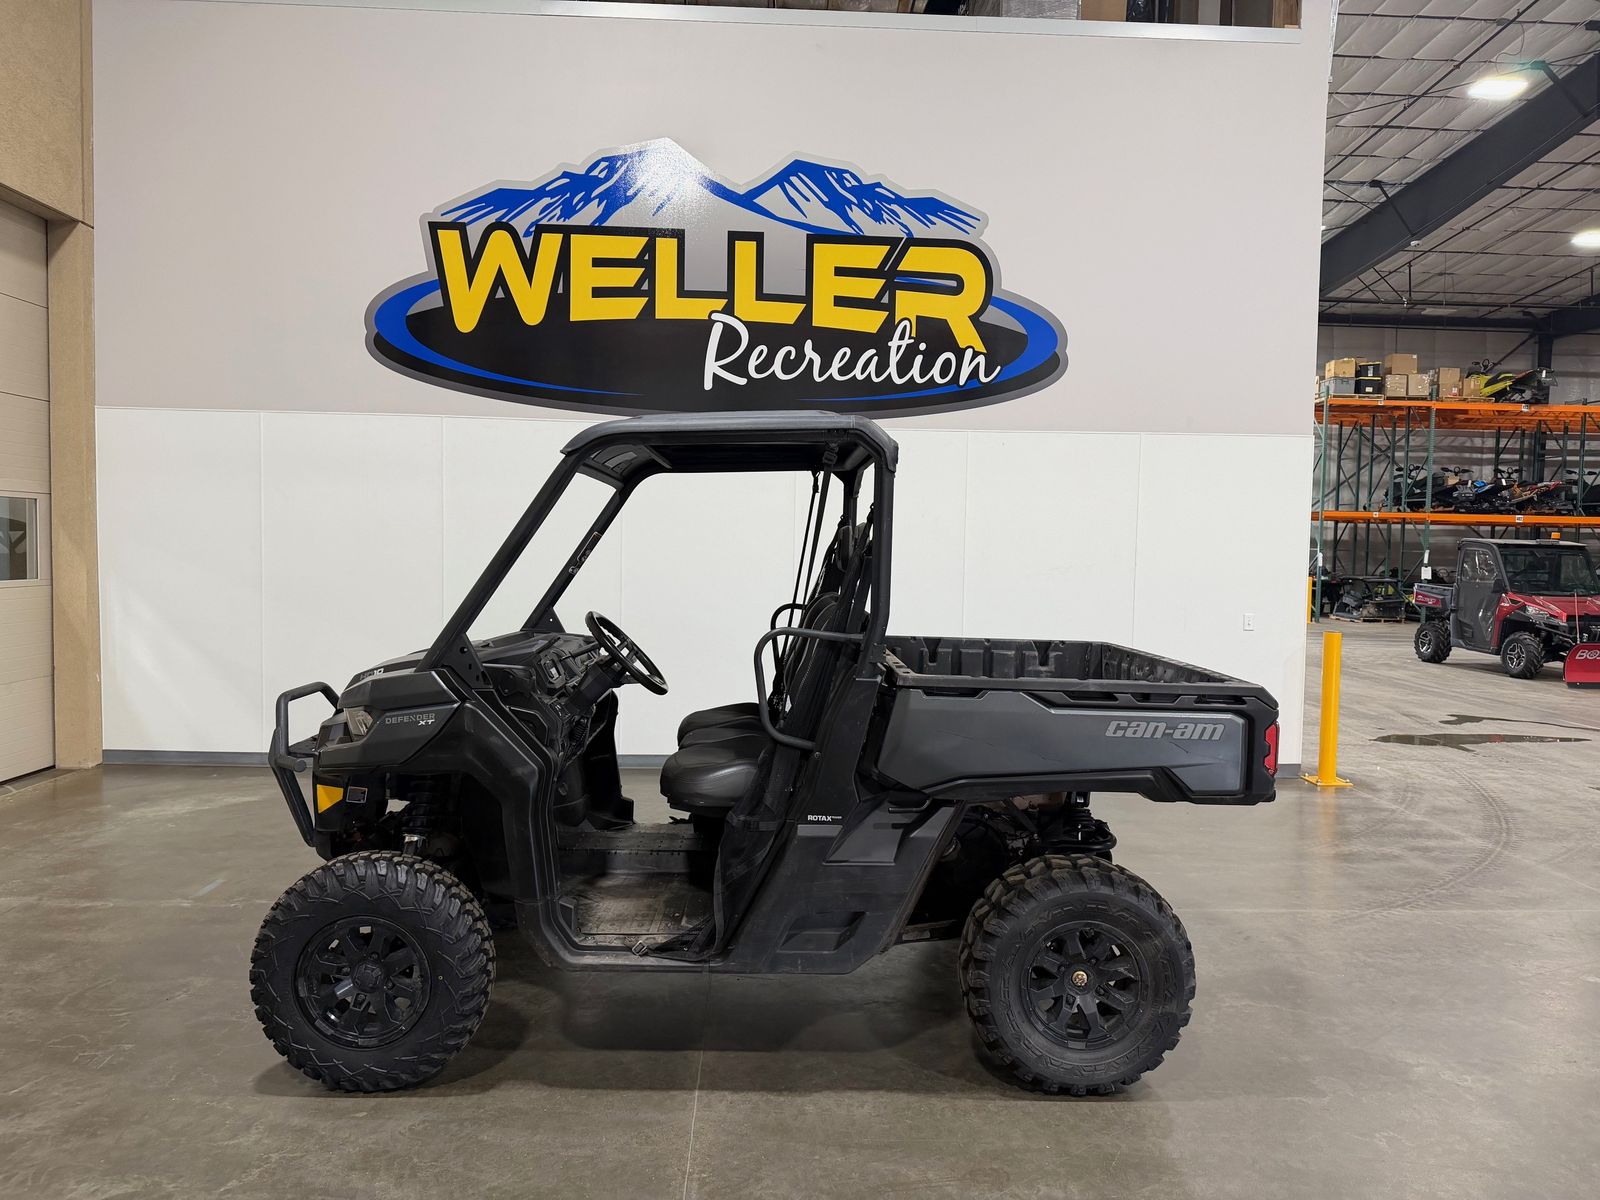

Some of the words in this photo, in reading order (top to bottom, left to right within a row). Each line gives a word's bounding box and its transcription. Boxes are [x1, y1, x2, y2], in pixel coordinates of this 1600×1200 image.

[435, 227, 989, 354] WELLER
[703, 313, 1001, 391] Recreation
[385, 712, 436, 724] DEFENDER
[807, 814, 832, 822] ROTAX
